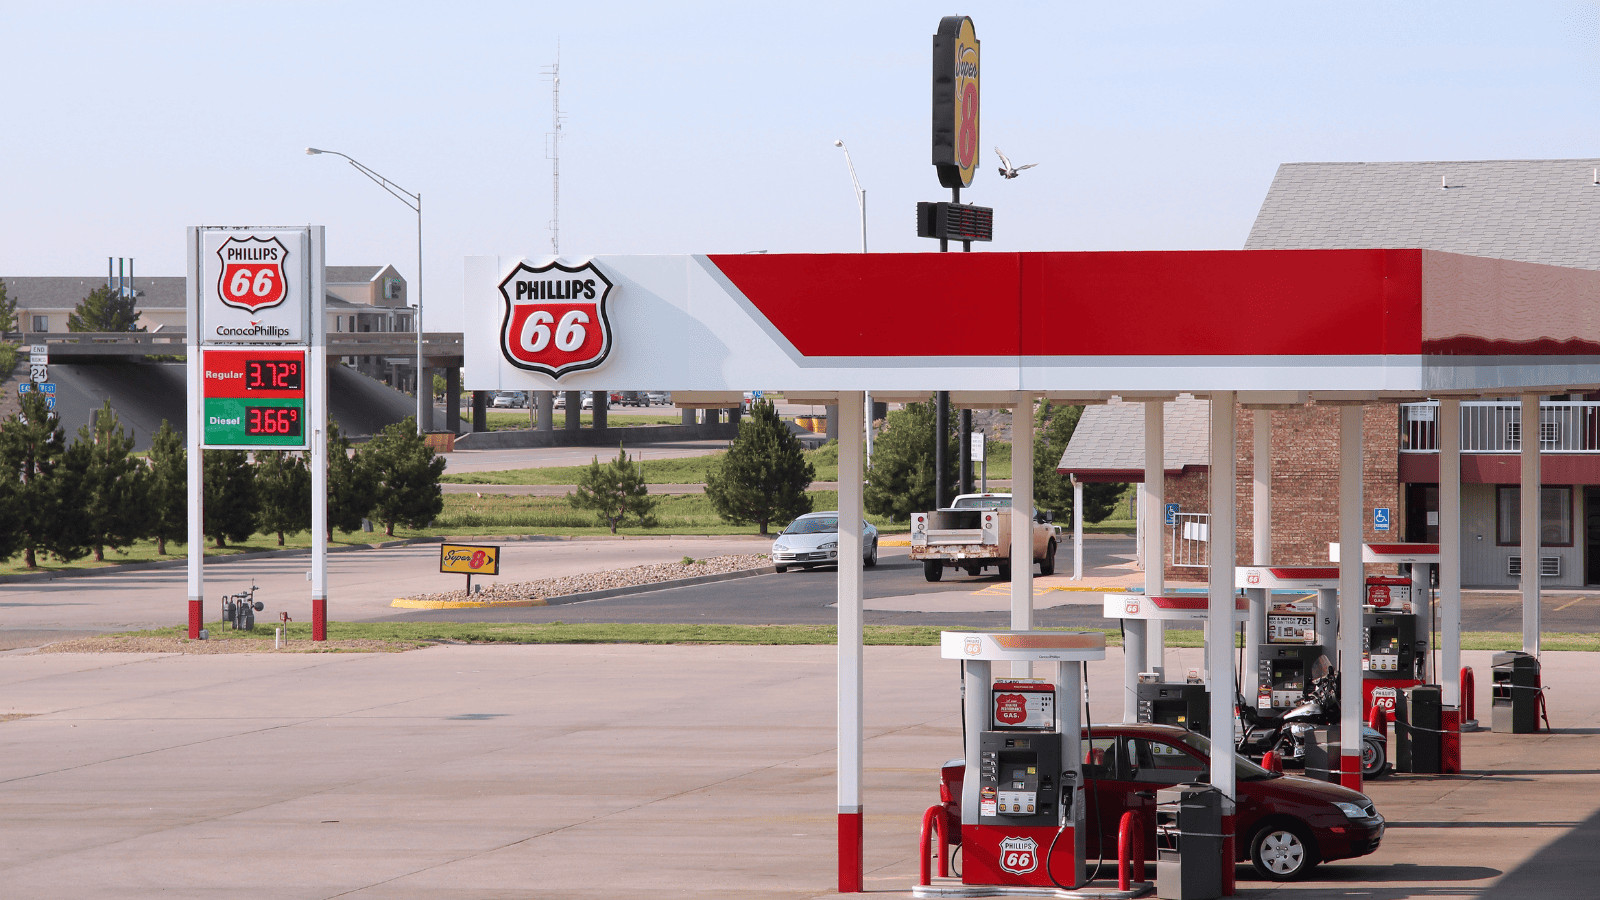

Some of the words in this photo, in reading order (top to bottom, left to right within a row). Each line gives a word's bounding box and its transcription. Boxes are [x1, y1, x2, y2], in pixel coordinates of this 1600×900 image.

[955, 43, 977, 95] Super
[959, 82, 977, 170] 8
[228, 248, 278, 260] PHILLIPS
[230, 268, 275, 297] 66
[516, 279, 596, 300] PHILLIPS
[216, 325, 289, 338] ConocoPhillips
[520, 310, 590, 353] 66
[32, 369, 45, 379] 24
[205, 371, 244, 380] Regular
[209, 416, 241, 425] Diesel
[444, 549, 472, 566] Super
[468, 550, 486, 569] 8
[967, 644, 979, 653] 66
[1006, 853, 1030, 867] 66
